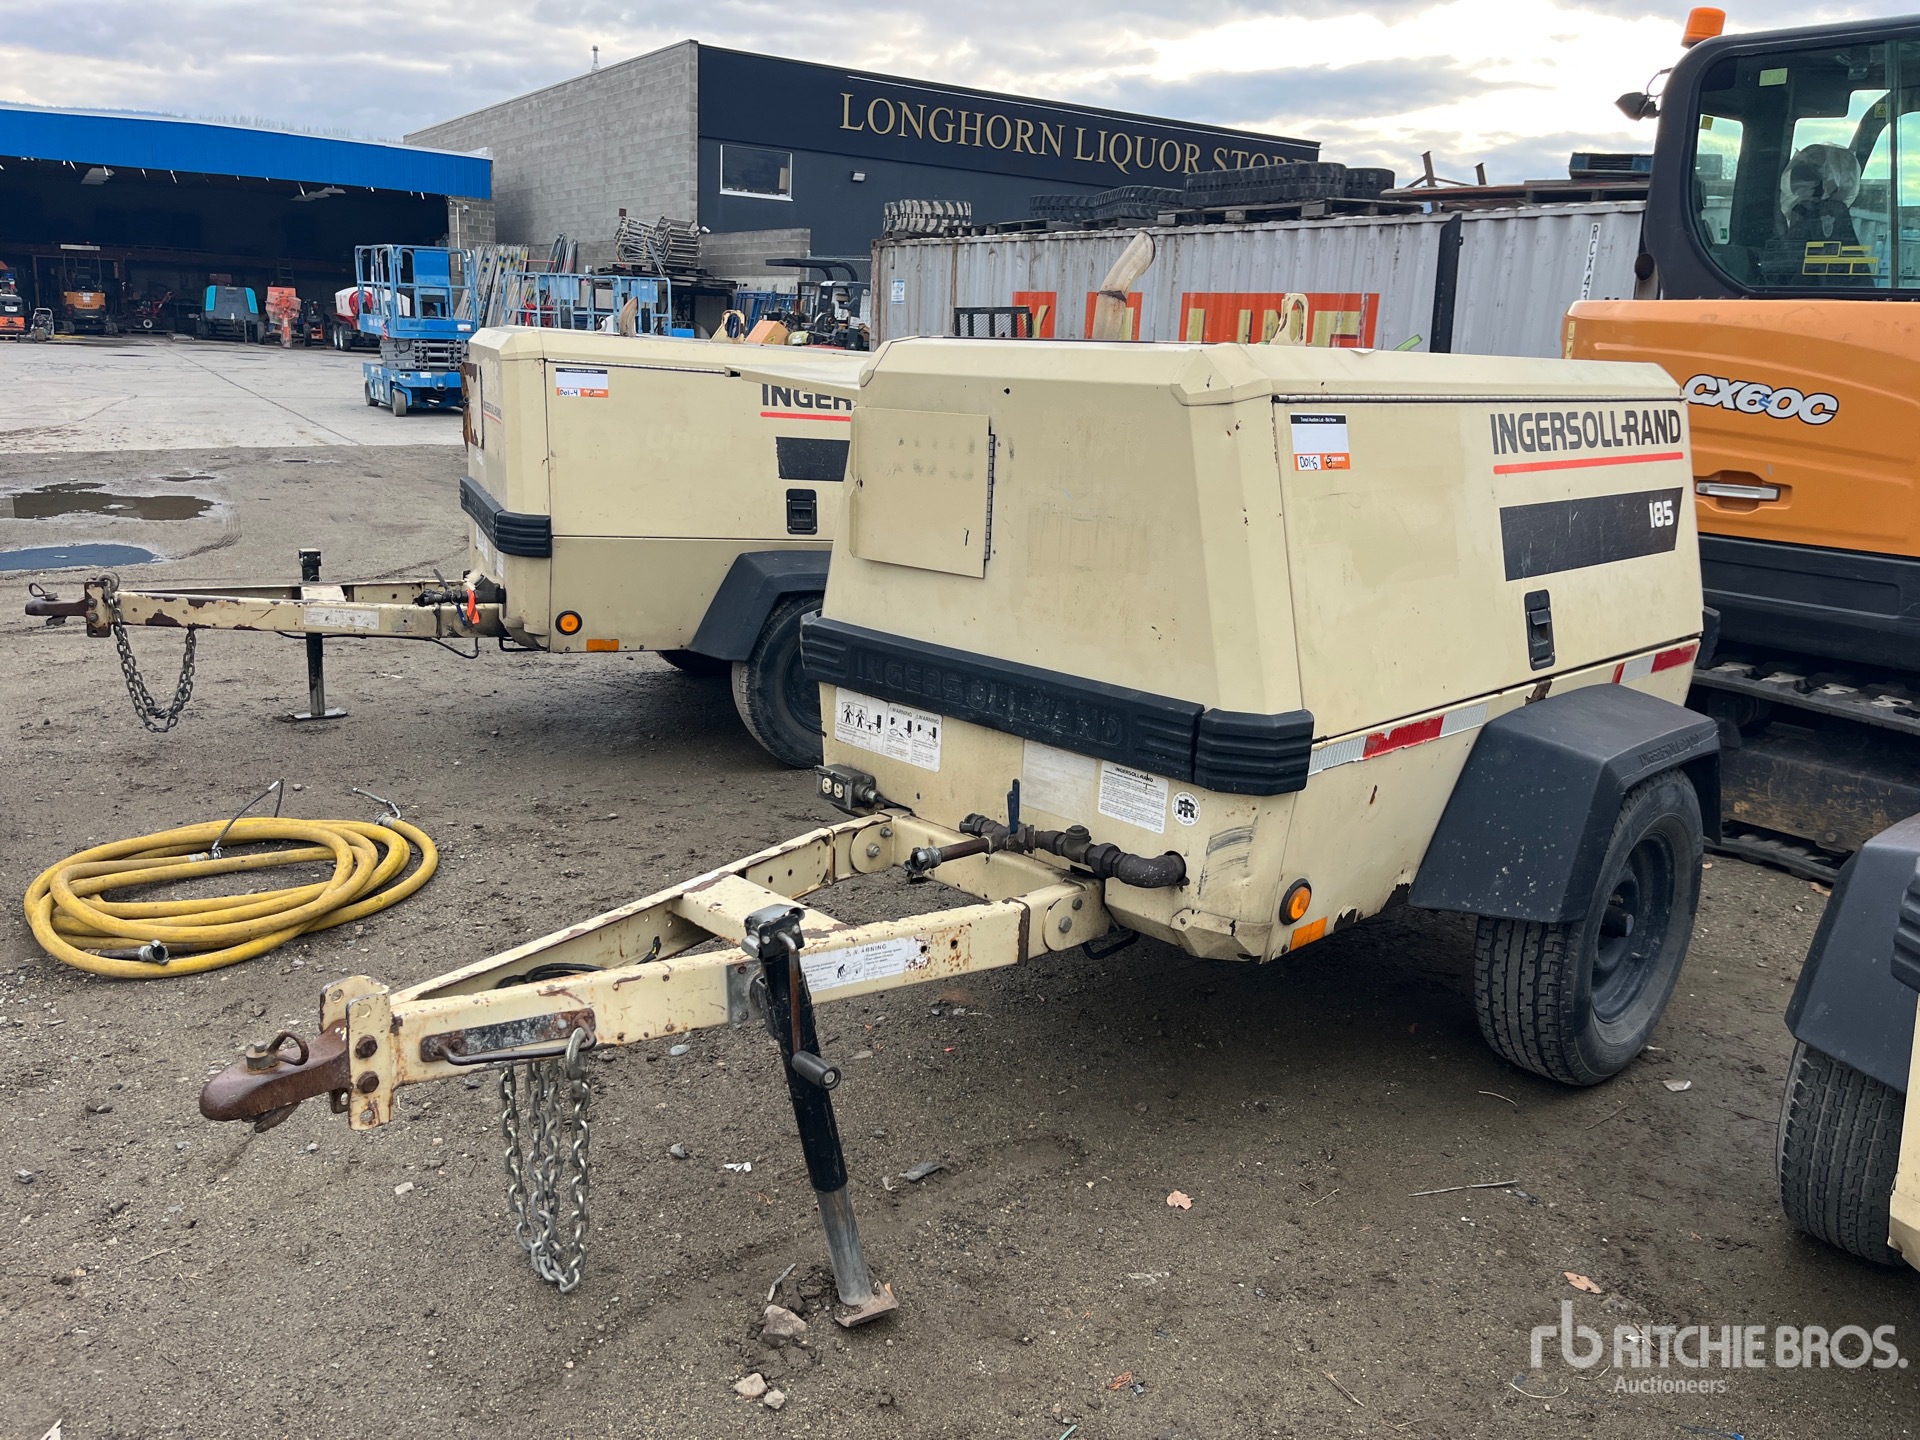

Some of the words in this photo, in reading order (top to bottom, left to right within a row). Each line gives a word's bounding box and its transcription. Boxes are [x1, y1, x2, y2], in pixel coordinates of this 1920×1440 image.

[839, 92, 1066, 158] LONGHORN
[1073, 126, 1201, 175] LIQUOR
[1213, 147, 1308, 171] STO
[1683, 374, 1840, 425] CX60C
[1490, 409, 1682, 455] INGERSOLL-RAND
[1649, 500, 1674, 529] 185
